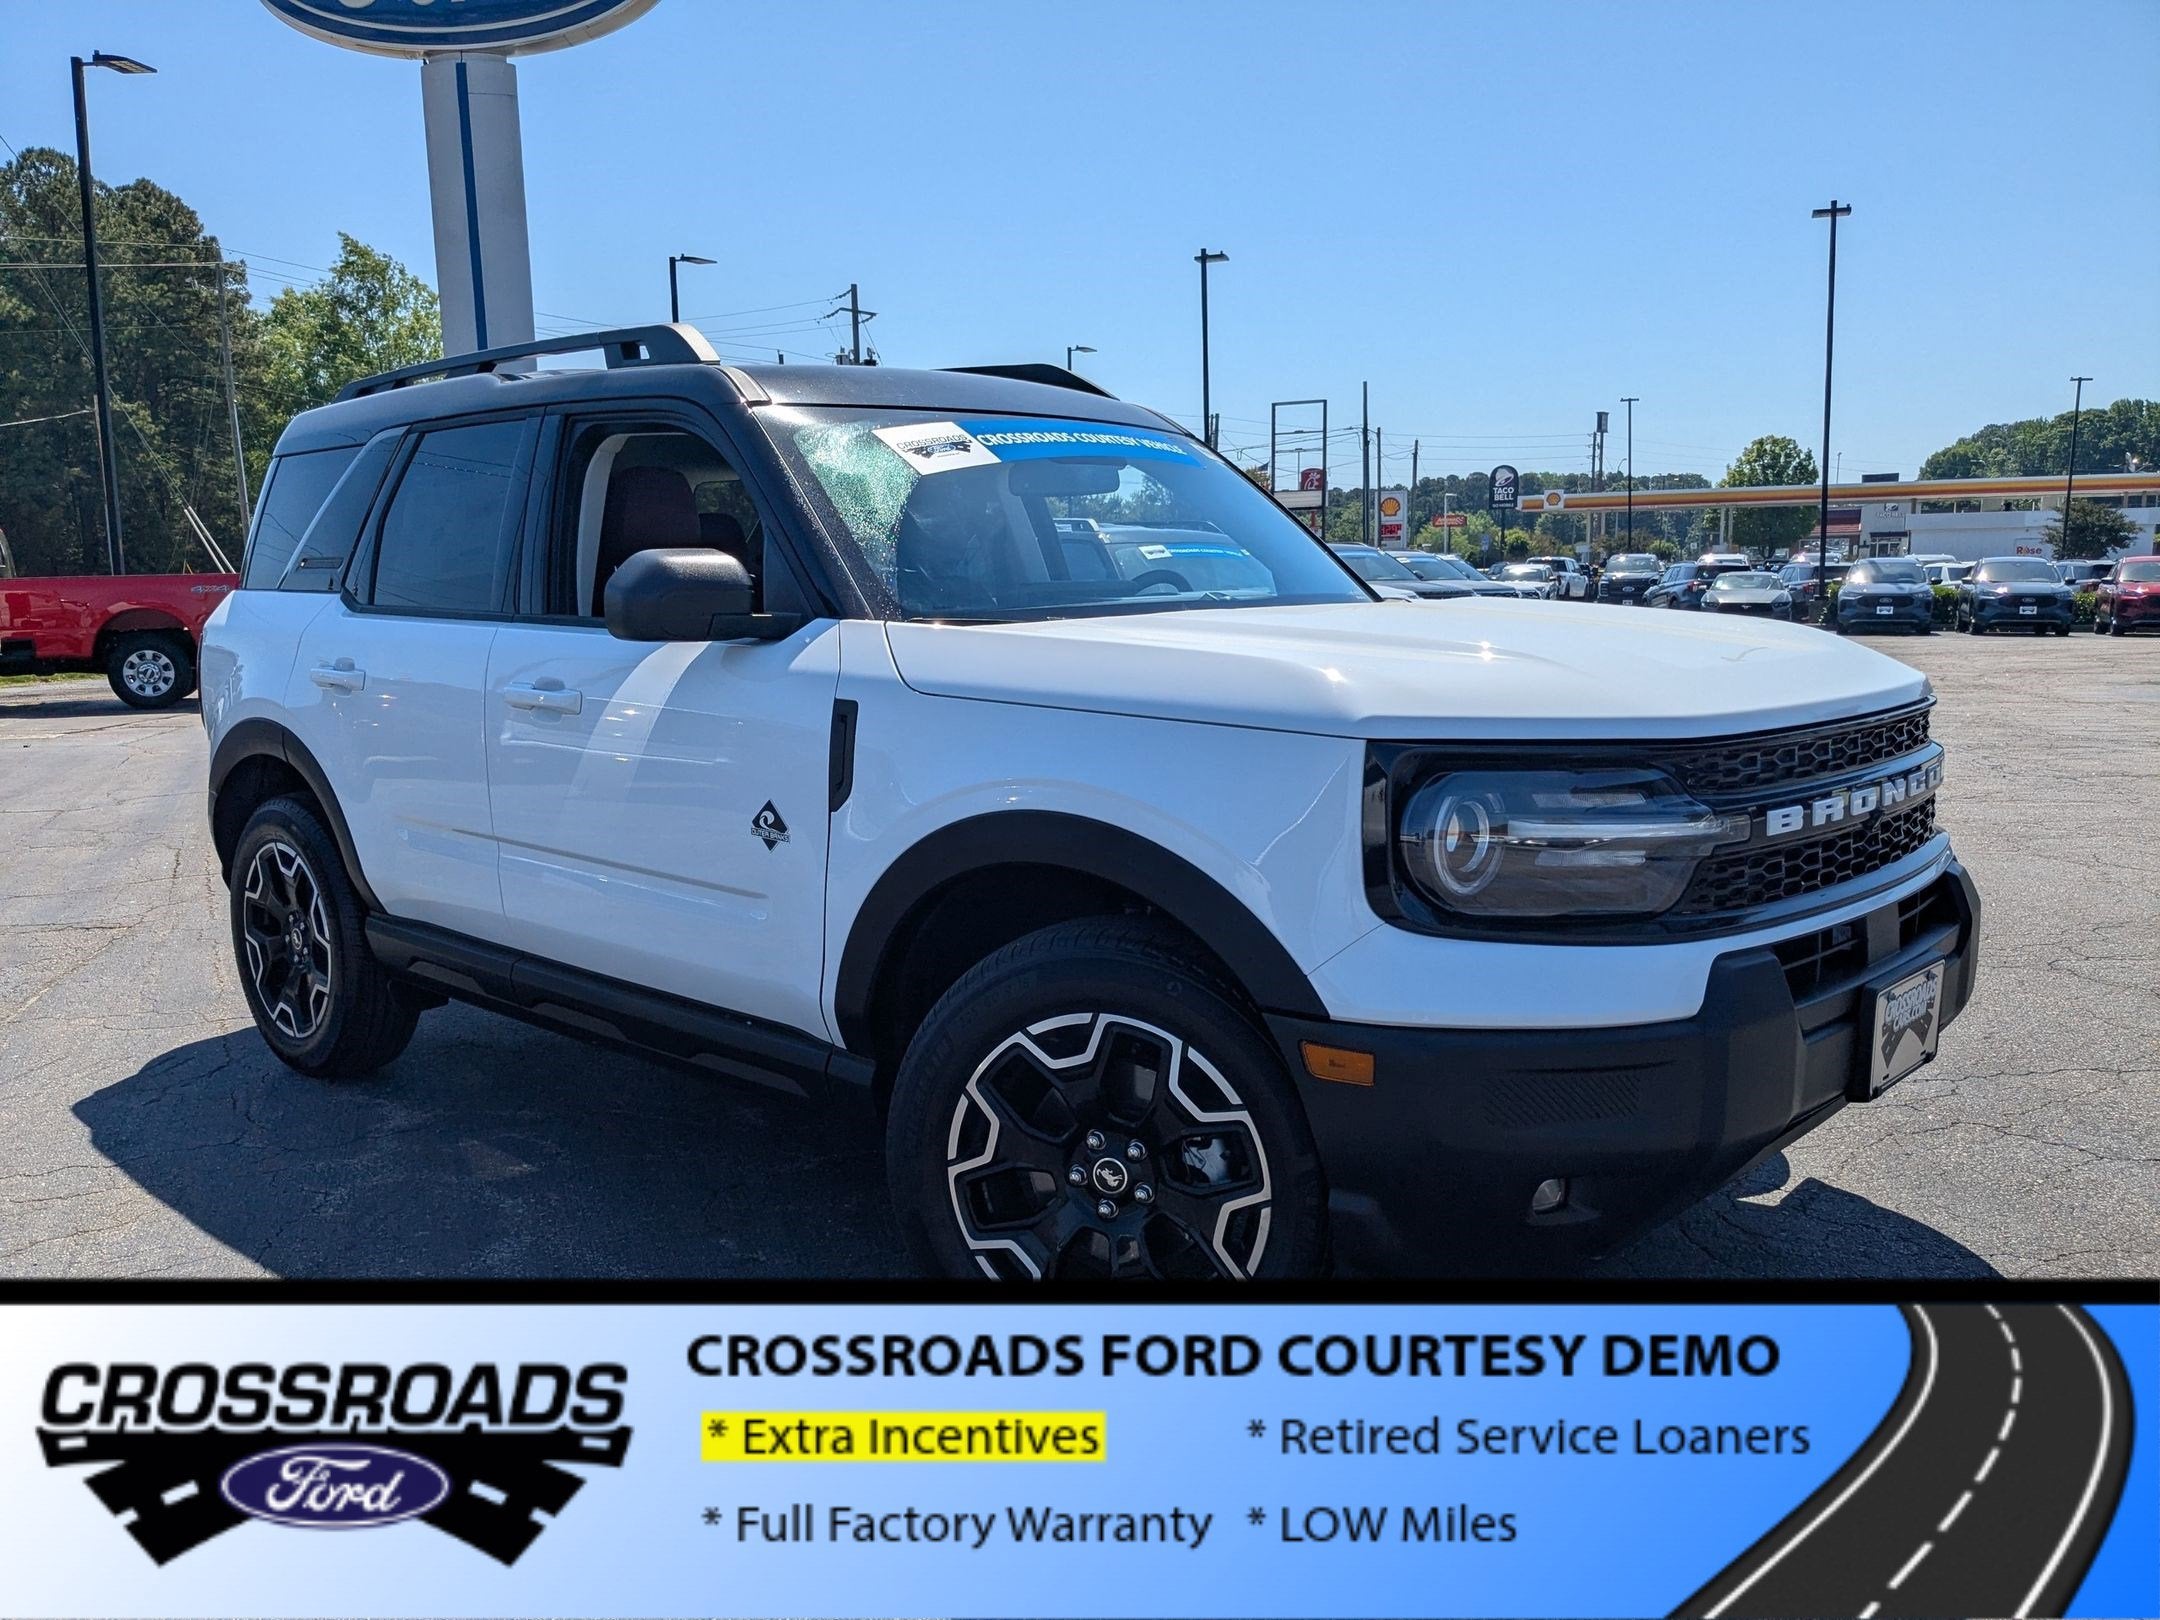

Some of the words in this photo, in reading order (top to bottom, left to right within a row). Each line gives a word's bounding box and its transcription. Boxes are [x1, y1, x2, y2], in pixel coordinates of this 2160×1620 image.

[897, 433, 968, 450] CROSSROADS
[977, 432, 1075, 447] CROSSROADS
[1073, 432, 1140, 448] COURTESY
[1136, 438, 1188, 456] VEHICLE
[2016, 546, 2043, 555] Rose
[1766, 763, 1942, 836] BRONCO
[752, 828, 770, 839] OUTER
[769, 831, 790, 843] BANKS
[1885, 979, 1938, 1024] CROSSROADS
